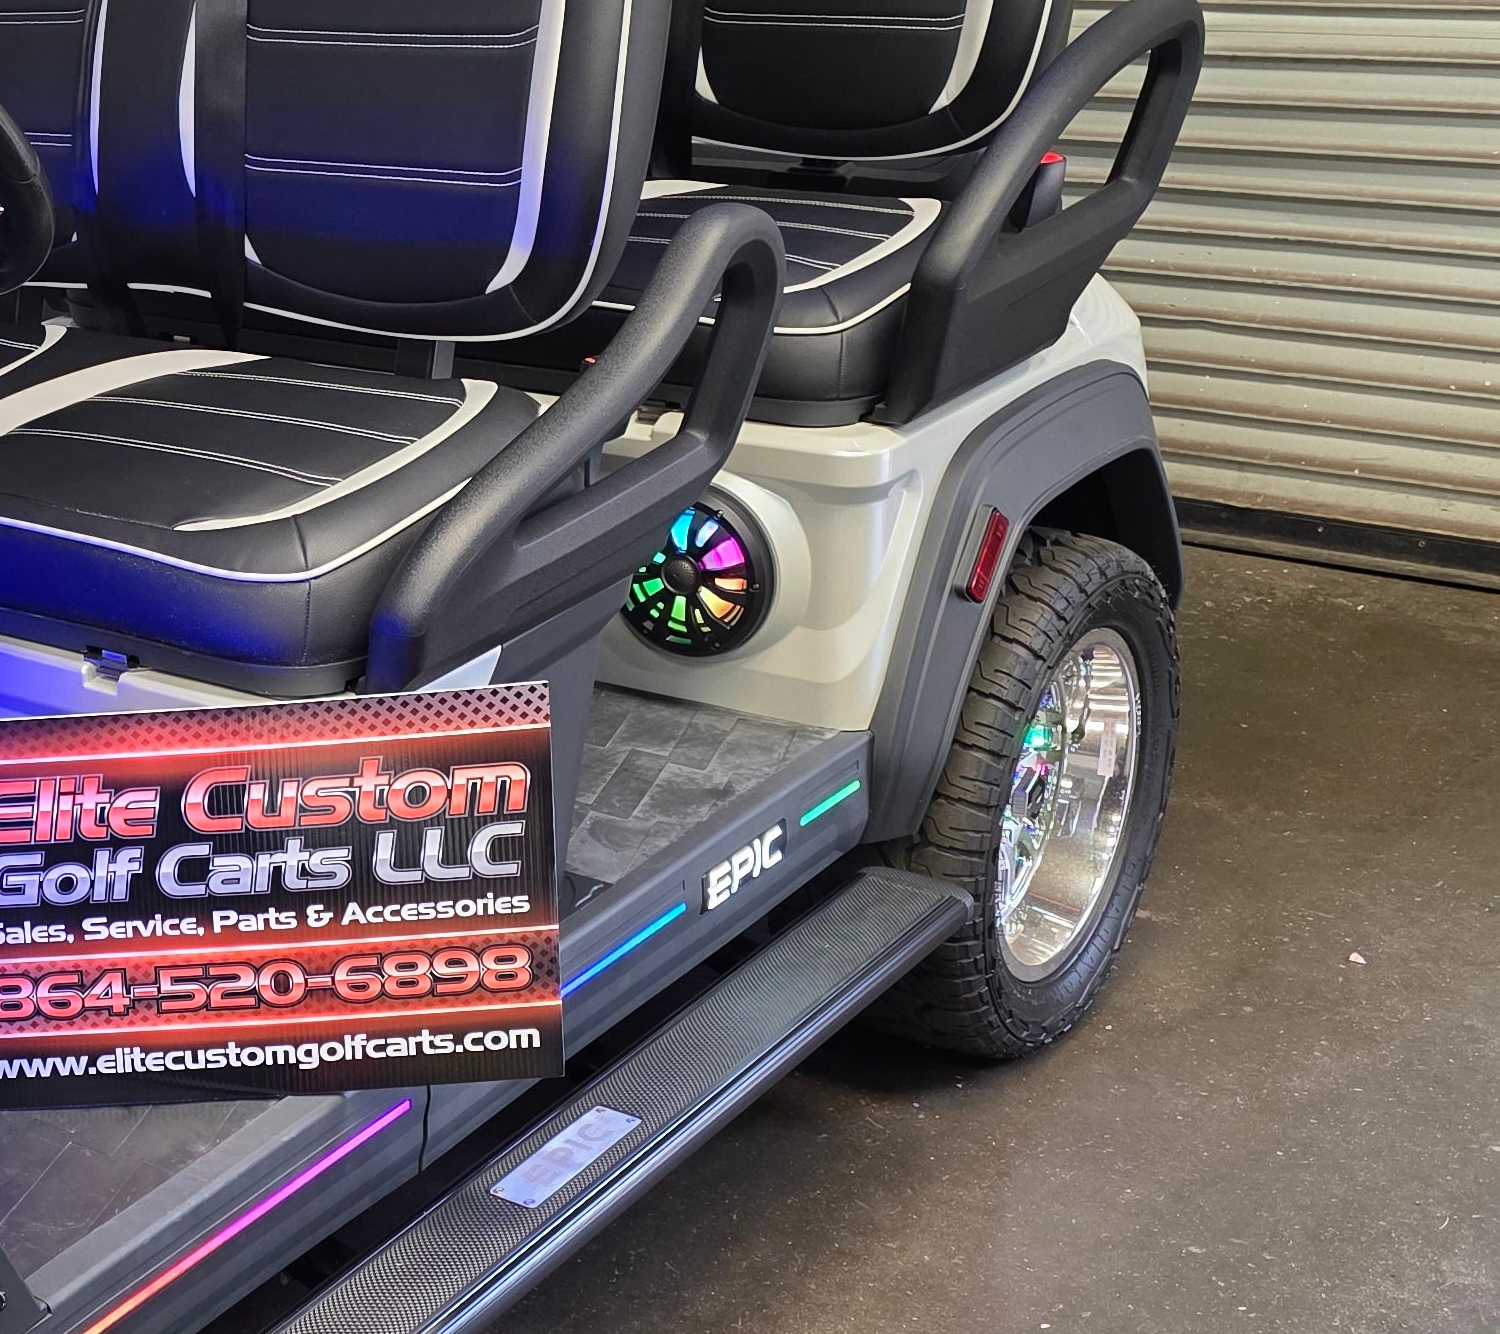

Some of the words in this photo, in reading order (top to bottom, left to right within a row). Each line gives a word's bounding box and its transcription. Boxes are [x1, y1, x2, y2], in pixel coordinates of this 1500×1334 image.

[181, 755, 531, 835] Custom
[155, 836, 353, 900] Carts
[372, 819, 527, 885] LLC
[705, 824, 785, 911] EPIC
[81, 913, 205, 941] Service,
[211, 907, 298, 934] Parts
[305, 903, 334, 928] &
[340, 891, 531, 926] Accessories
[521, 1122, 616, 1186] EPIC
